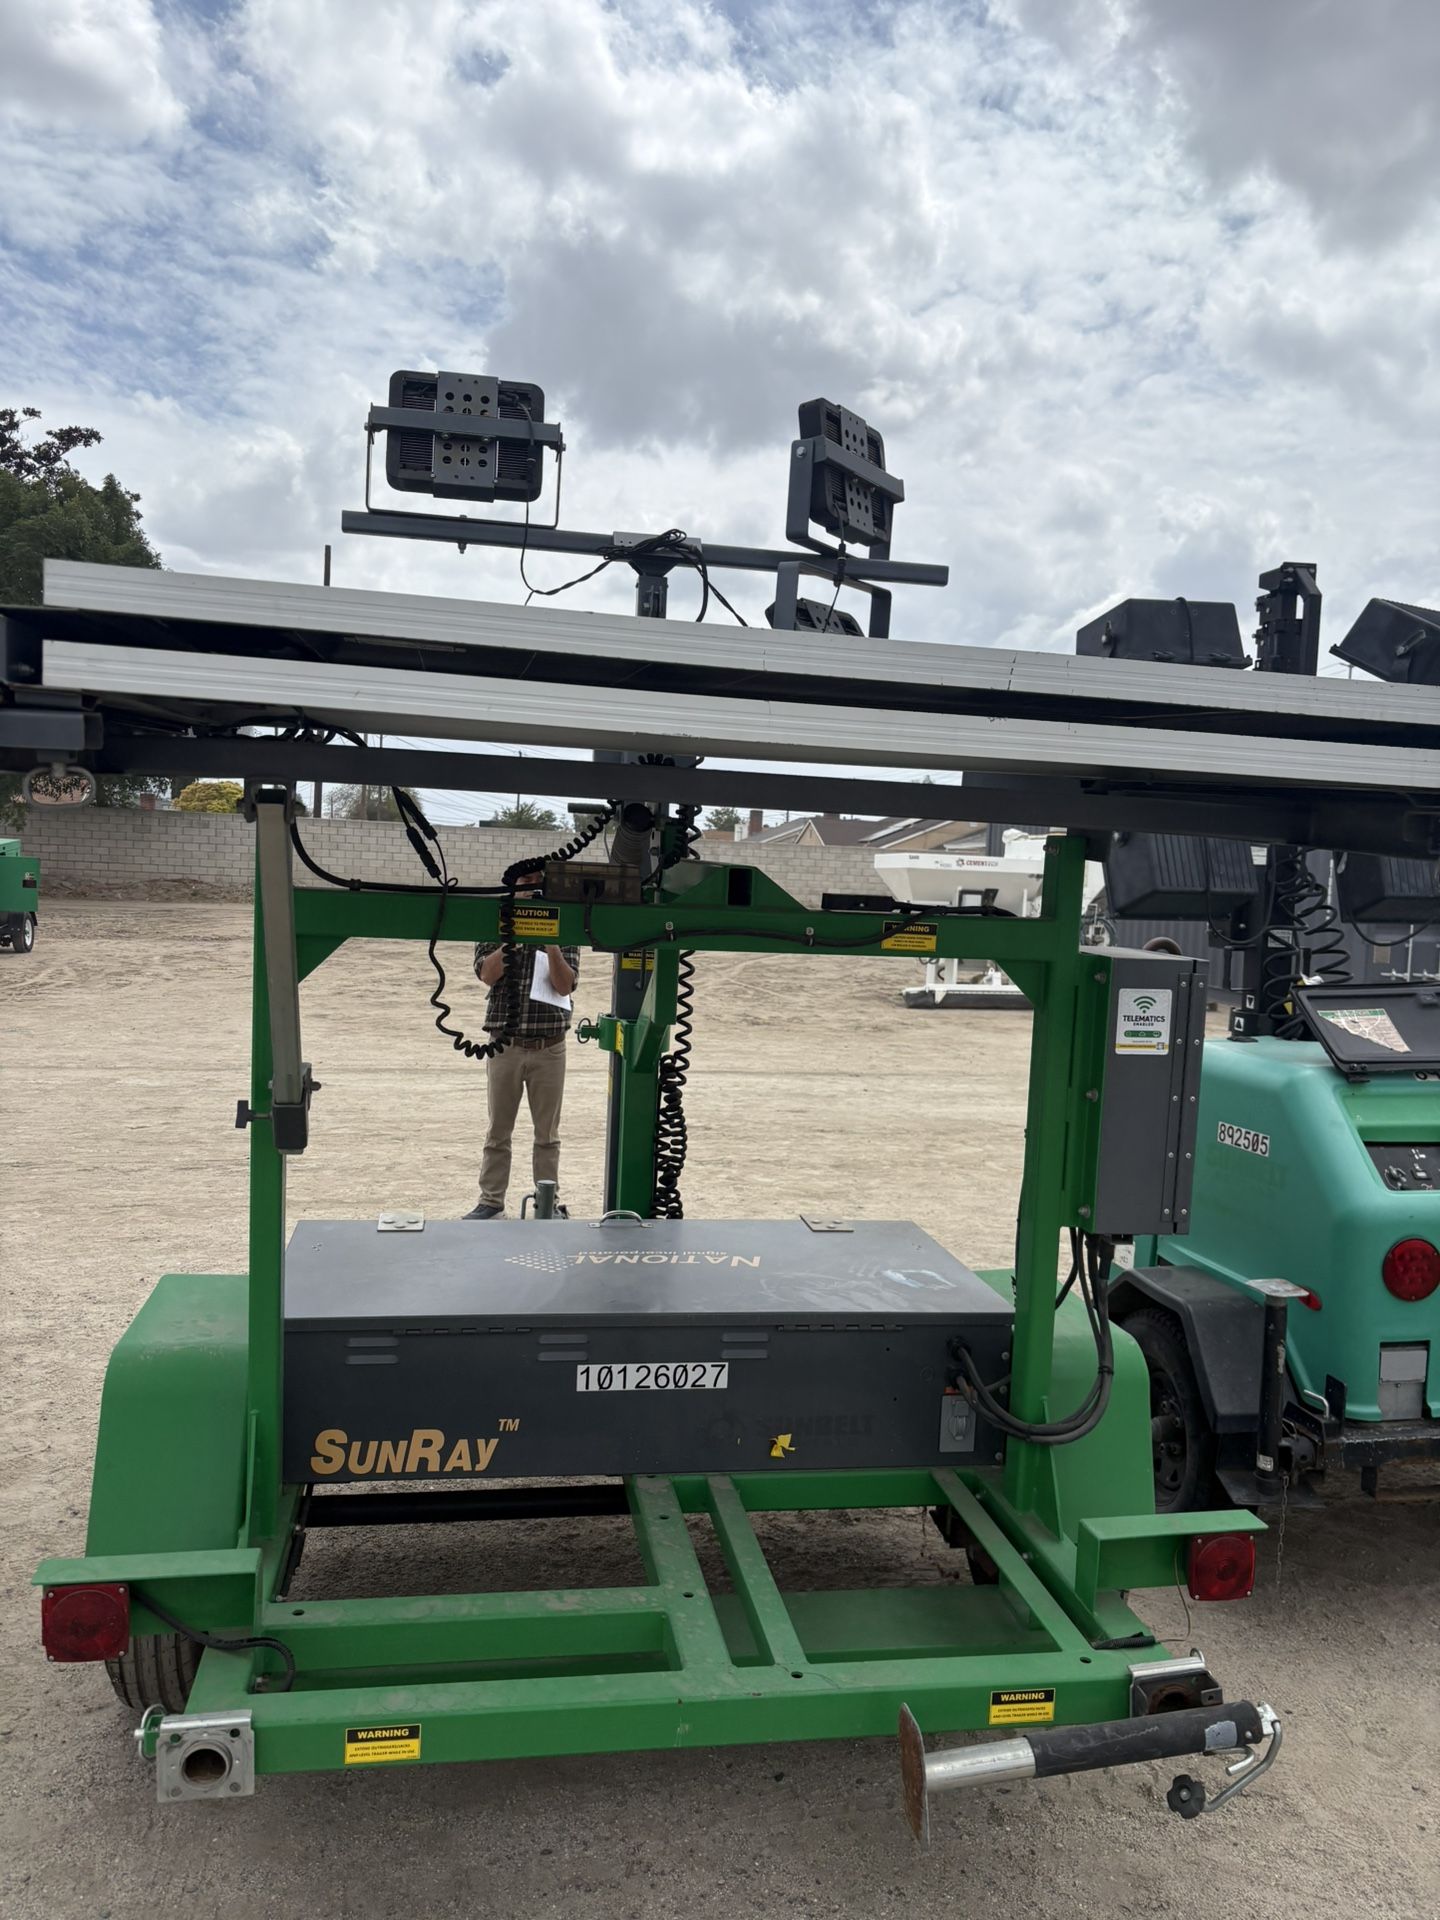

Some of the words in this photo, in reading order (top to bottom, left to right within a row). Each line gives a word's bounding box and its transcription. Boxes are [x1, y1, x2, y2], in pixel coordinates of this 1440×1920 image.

[514, 909, 550, 917] AUTION
[1122, 1015, 1166, 1023] TELEMATICS
[1219, 1123, 1269, 1155] 892505
[566, 1255, 762, 1268] NATIONAL
[580, 1364, 727, 1390] 10126027
[1001, 1692, 1045, 1701] WARNING
[357, 1728, 409, 1739] WARNING
